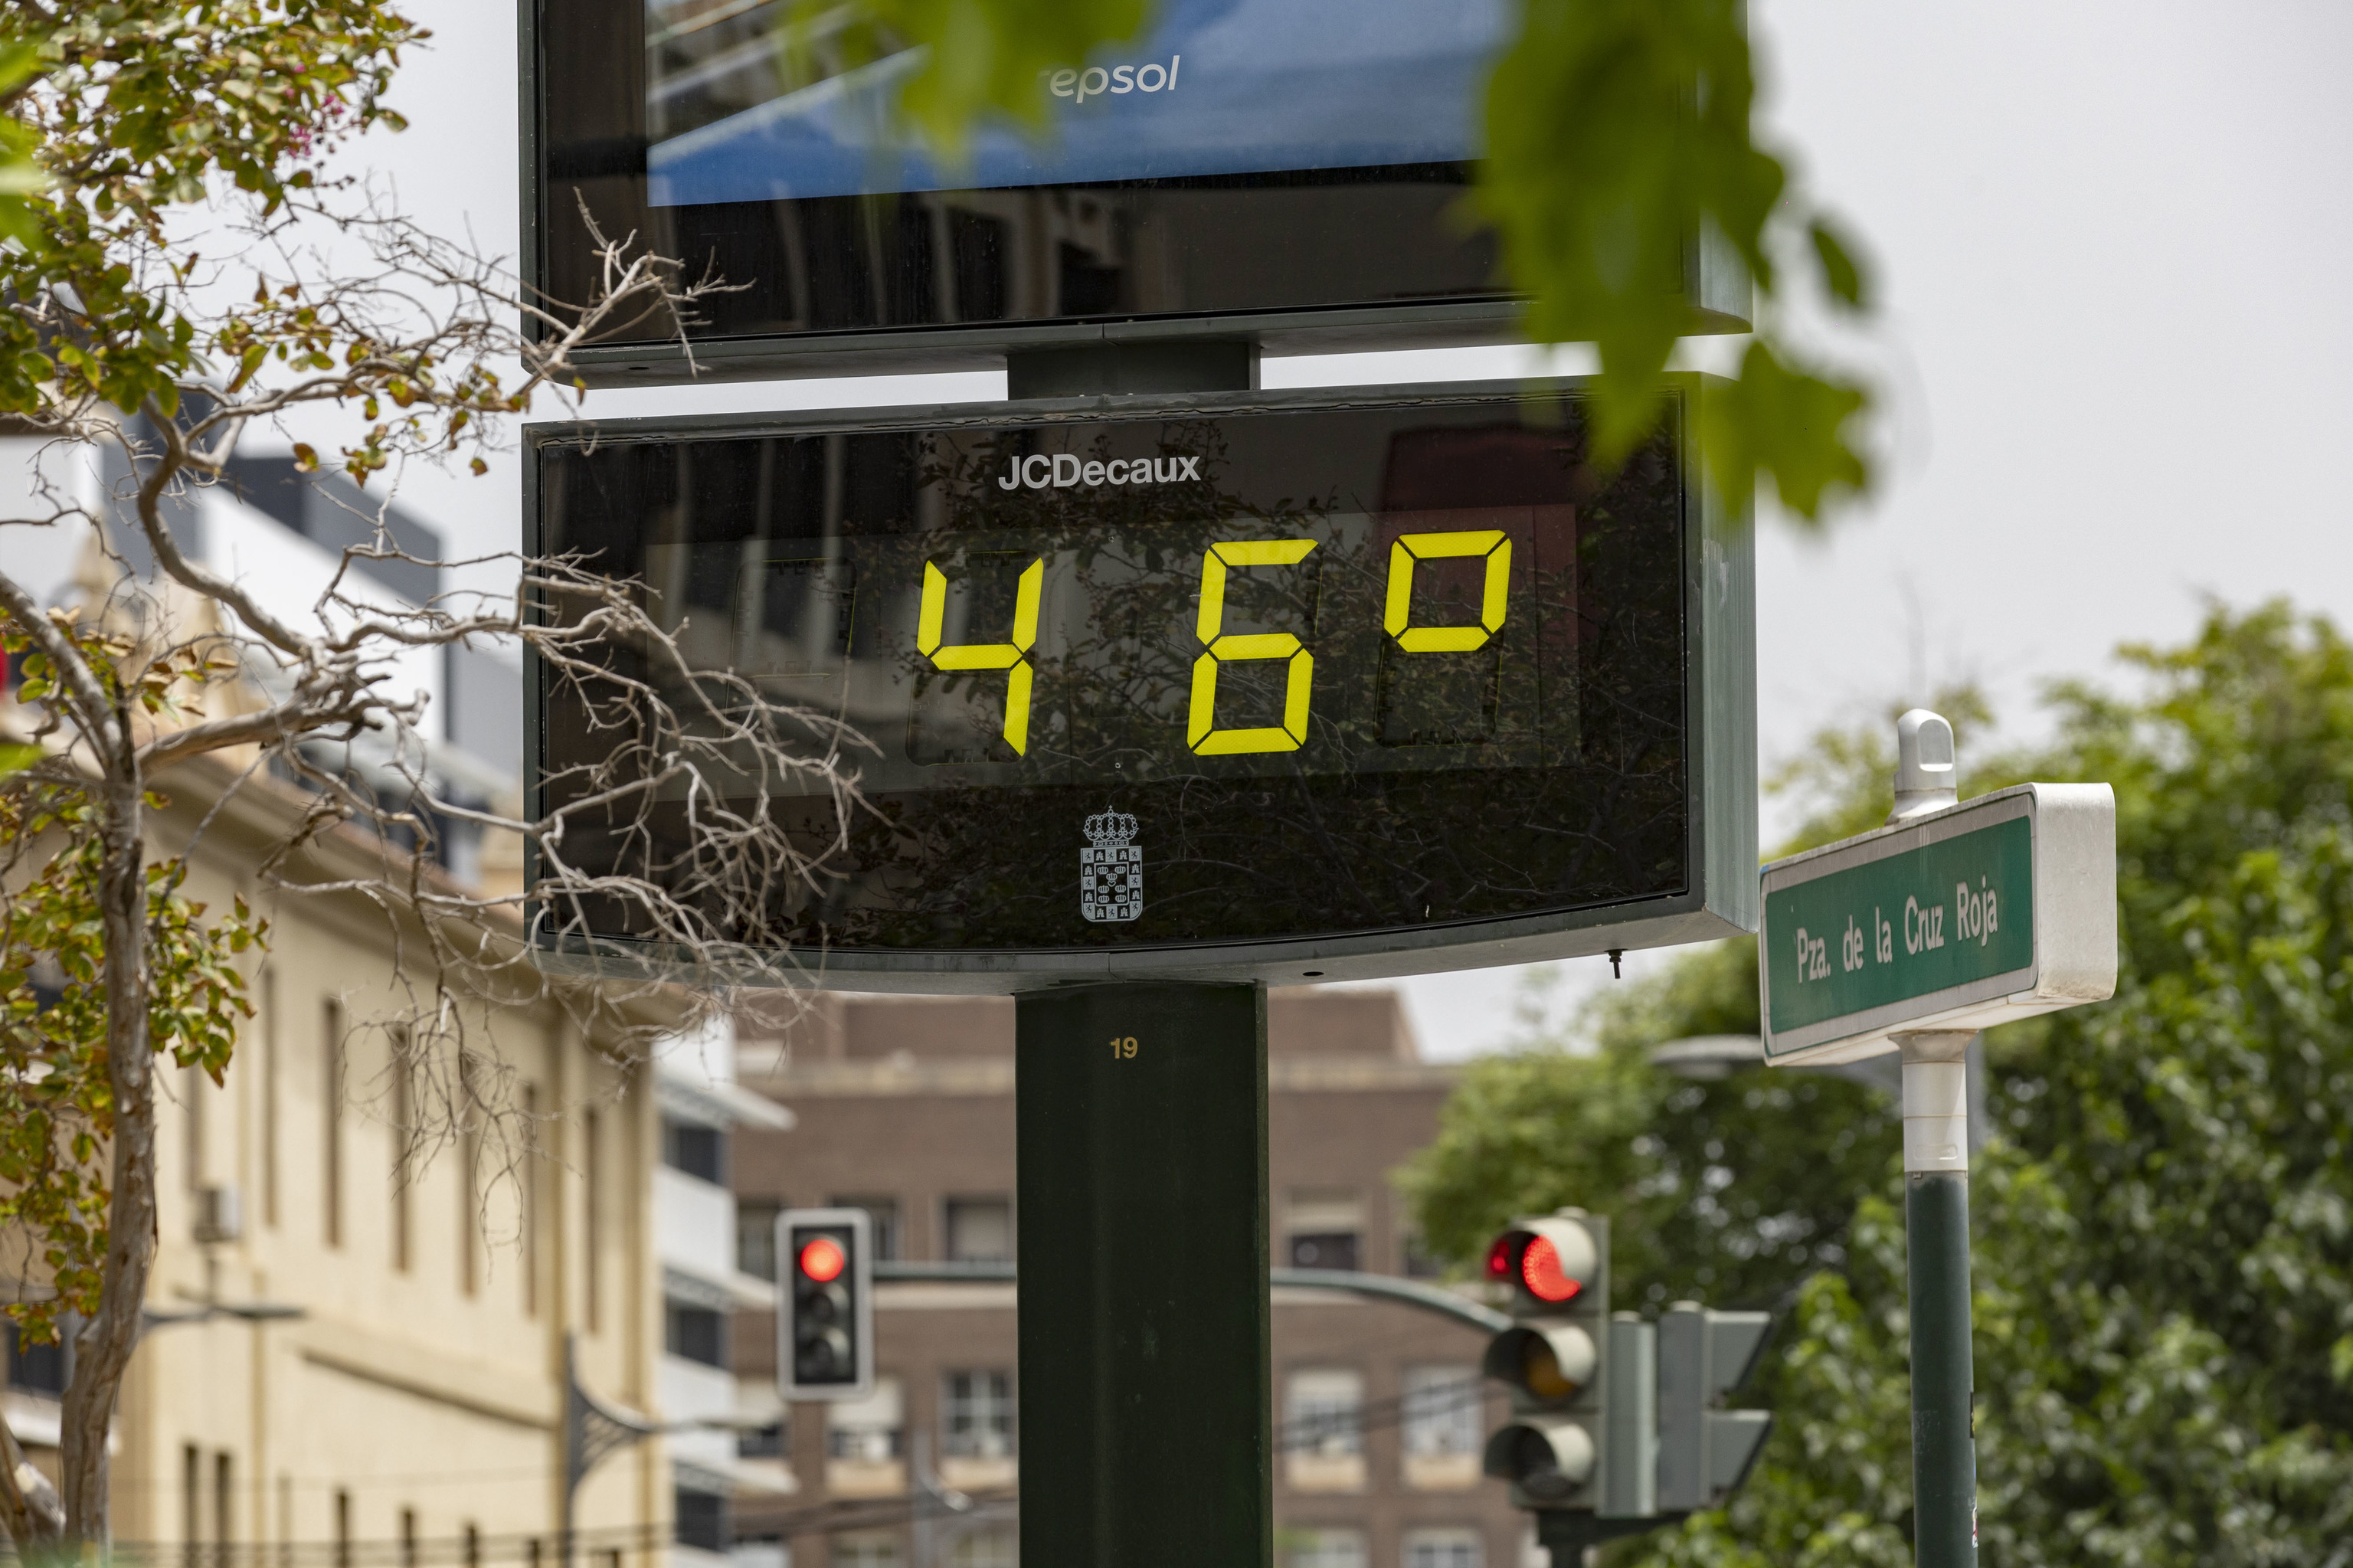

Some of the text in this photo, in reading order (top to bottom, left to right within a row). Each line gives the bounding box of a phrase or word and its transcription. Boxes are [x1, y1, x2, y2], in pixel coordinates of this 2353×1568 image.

[998, 453, 1201, 490] JCDecaux
[1796, 875, 1998, 984] Pza. de la Cruz Roja
[1110, 1036, 1138, 1059] 19
